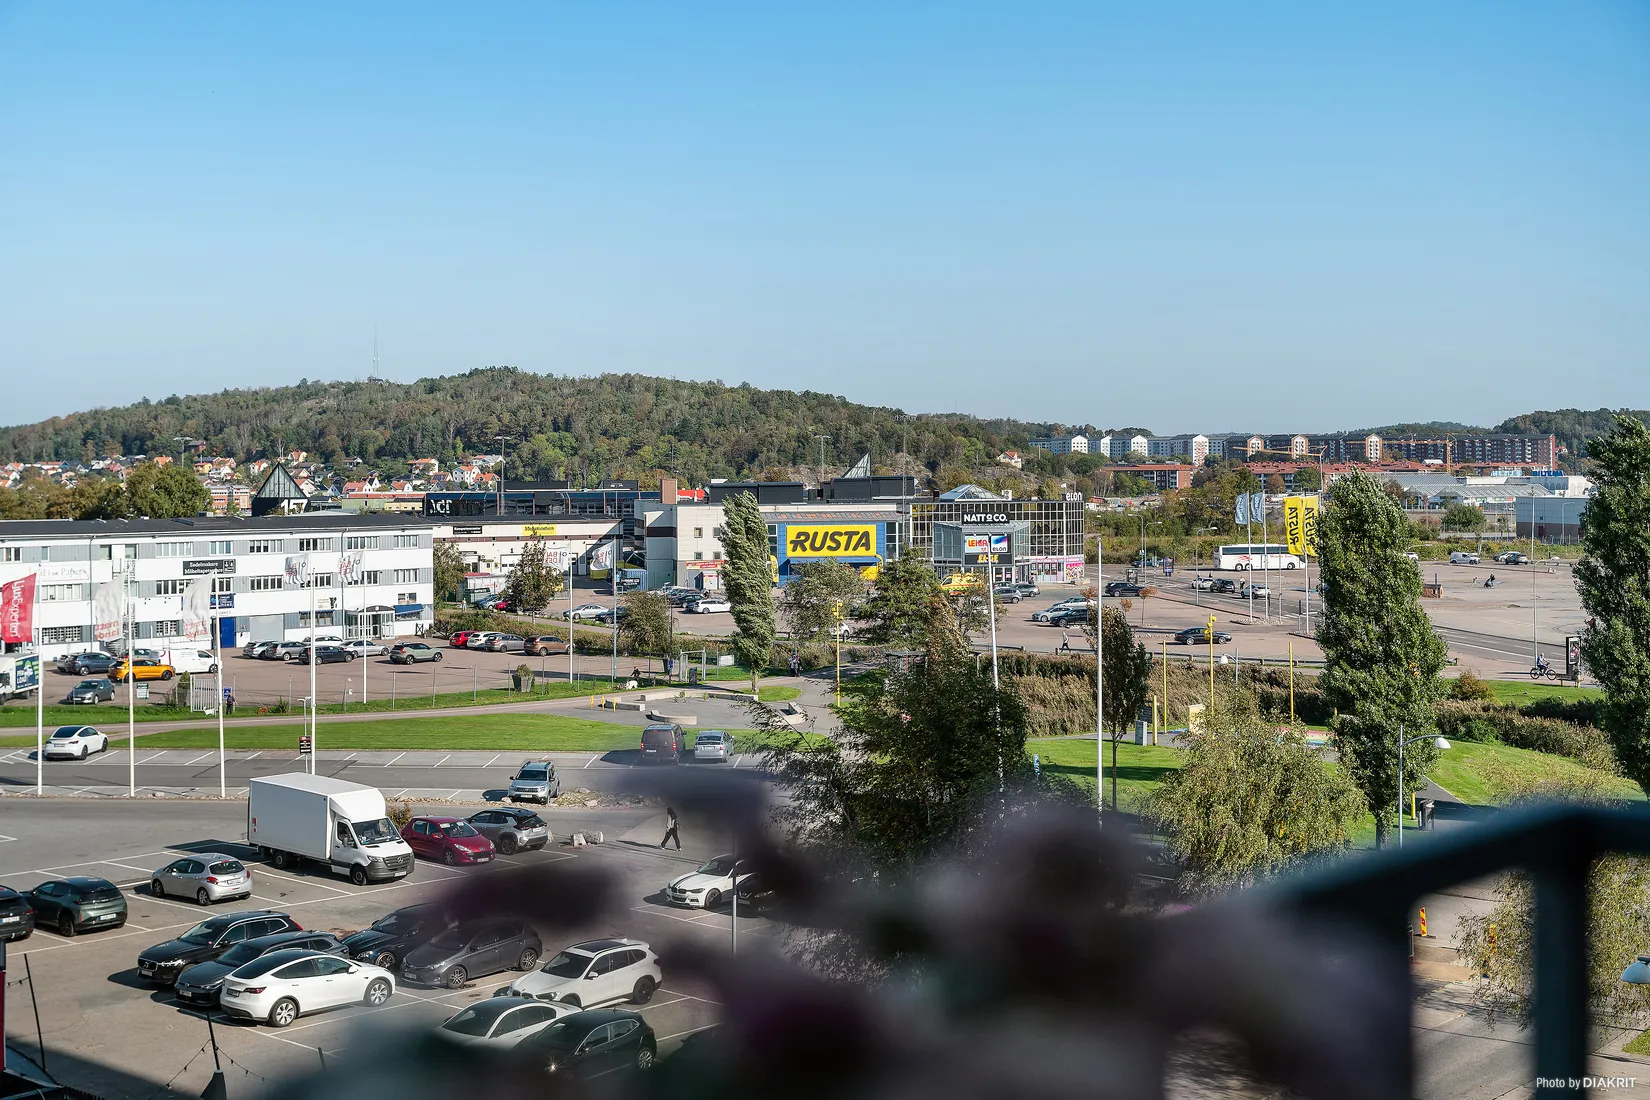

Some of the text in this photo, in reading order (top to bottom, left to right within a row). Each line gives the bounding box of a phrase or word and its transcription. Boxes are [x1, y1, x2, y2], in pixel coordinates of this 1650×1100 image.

[281, 499, 308, 515] 157
[789, 531, 871, 552] RUSTA
[10, 579, 25, 638] LjusExperten
